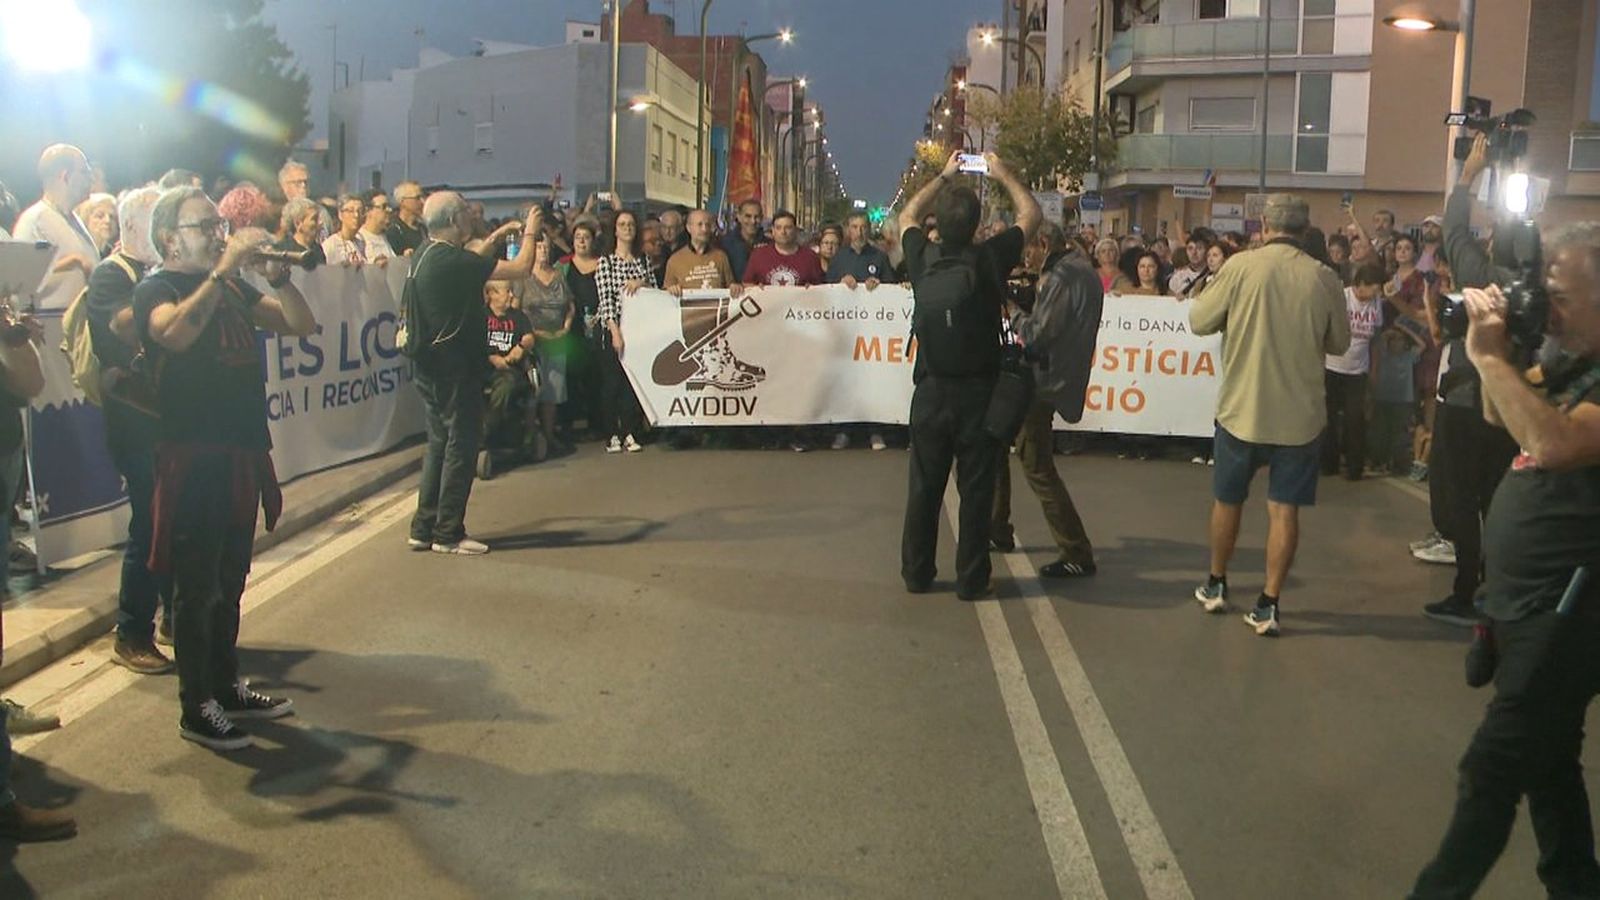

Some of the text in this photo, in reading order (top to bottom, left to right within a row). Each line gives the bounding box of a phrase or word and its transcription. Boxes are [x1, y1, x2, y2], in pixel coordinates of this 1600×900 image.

[876, 306, 895, 321] de
[1118, 316, 1132, 331] la
[1139, 318, 1187, 333] DANA
[1091, 340, 1215, 377] STÍCIA
[266, 390, 296, 421] CIA
[304, 386, 309, 413] I
[668, 396, 758, 417] AVDDV
[1085, 380, 1146, 413] CIÓ
